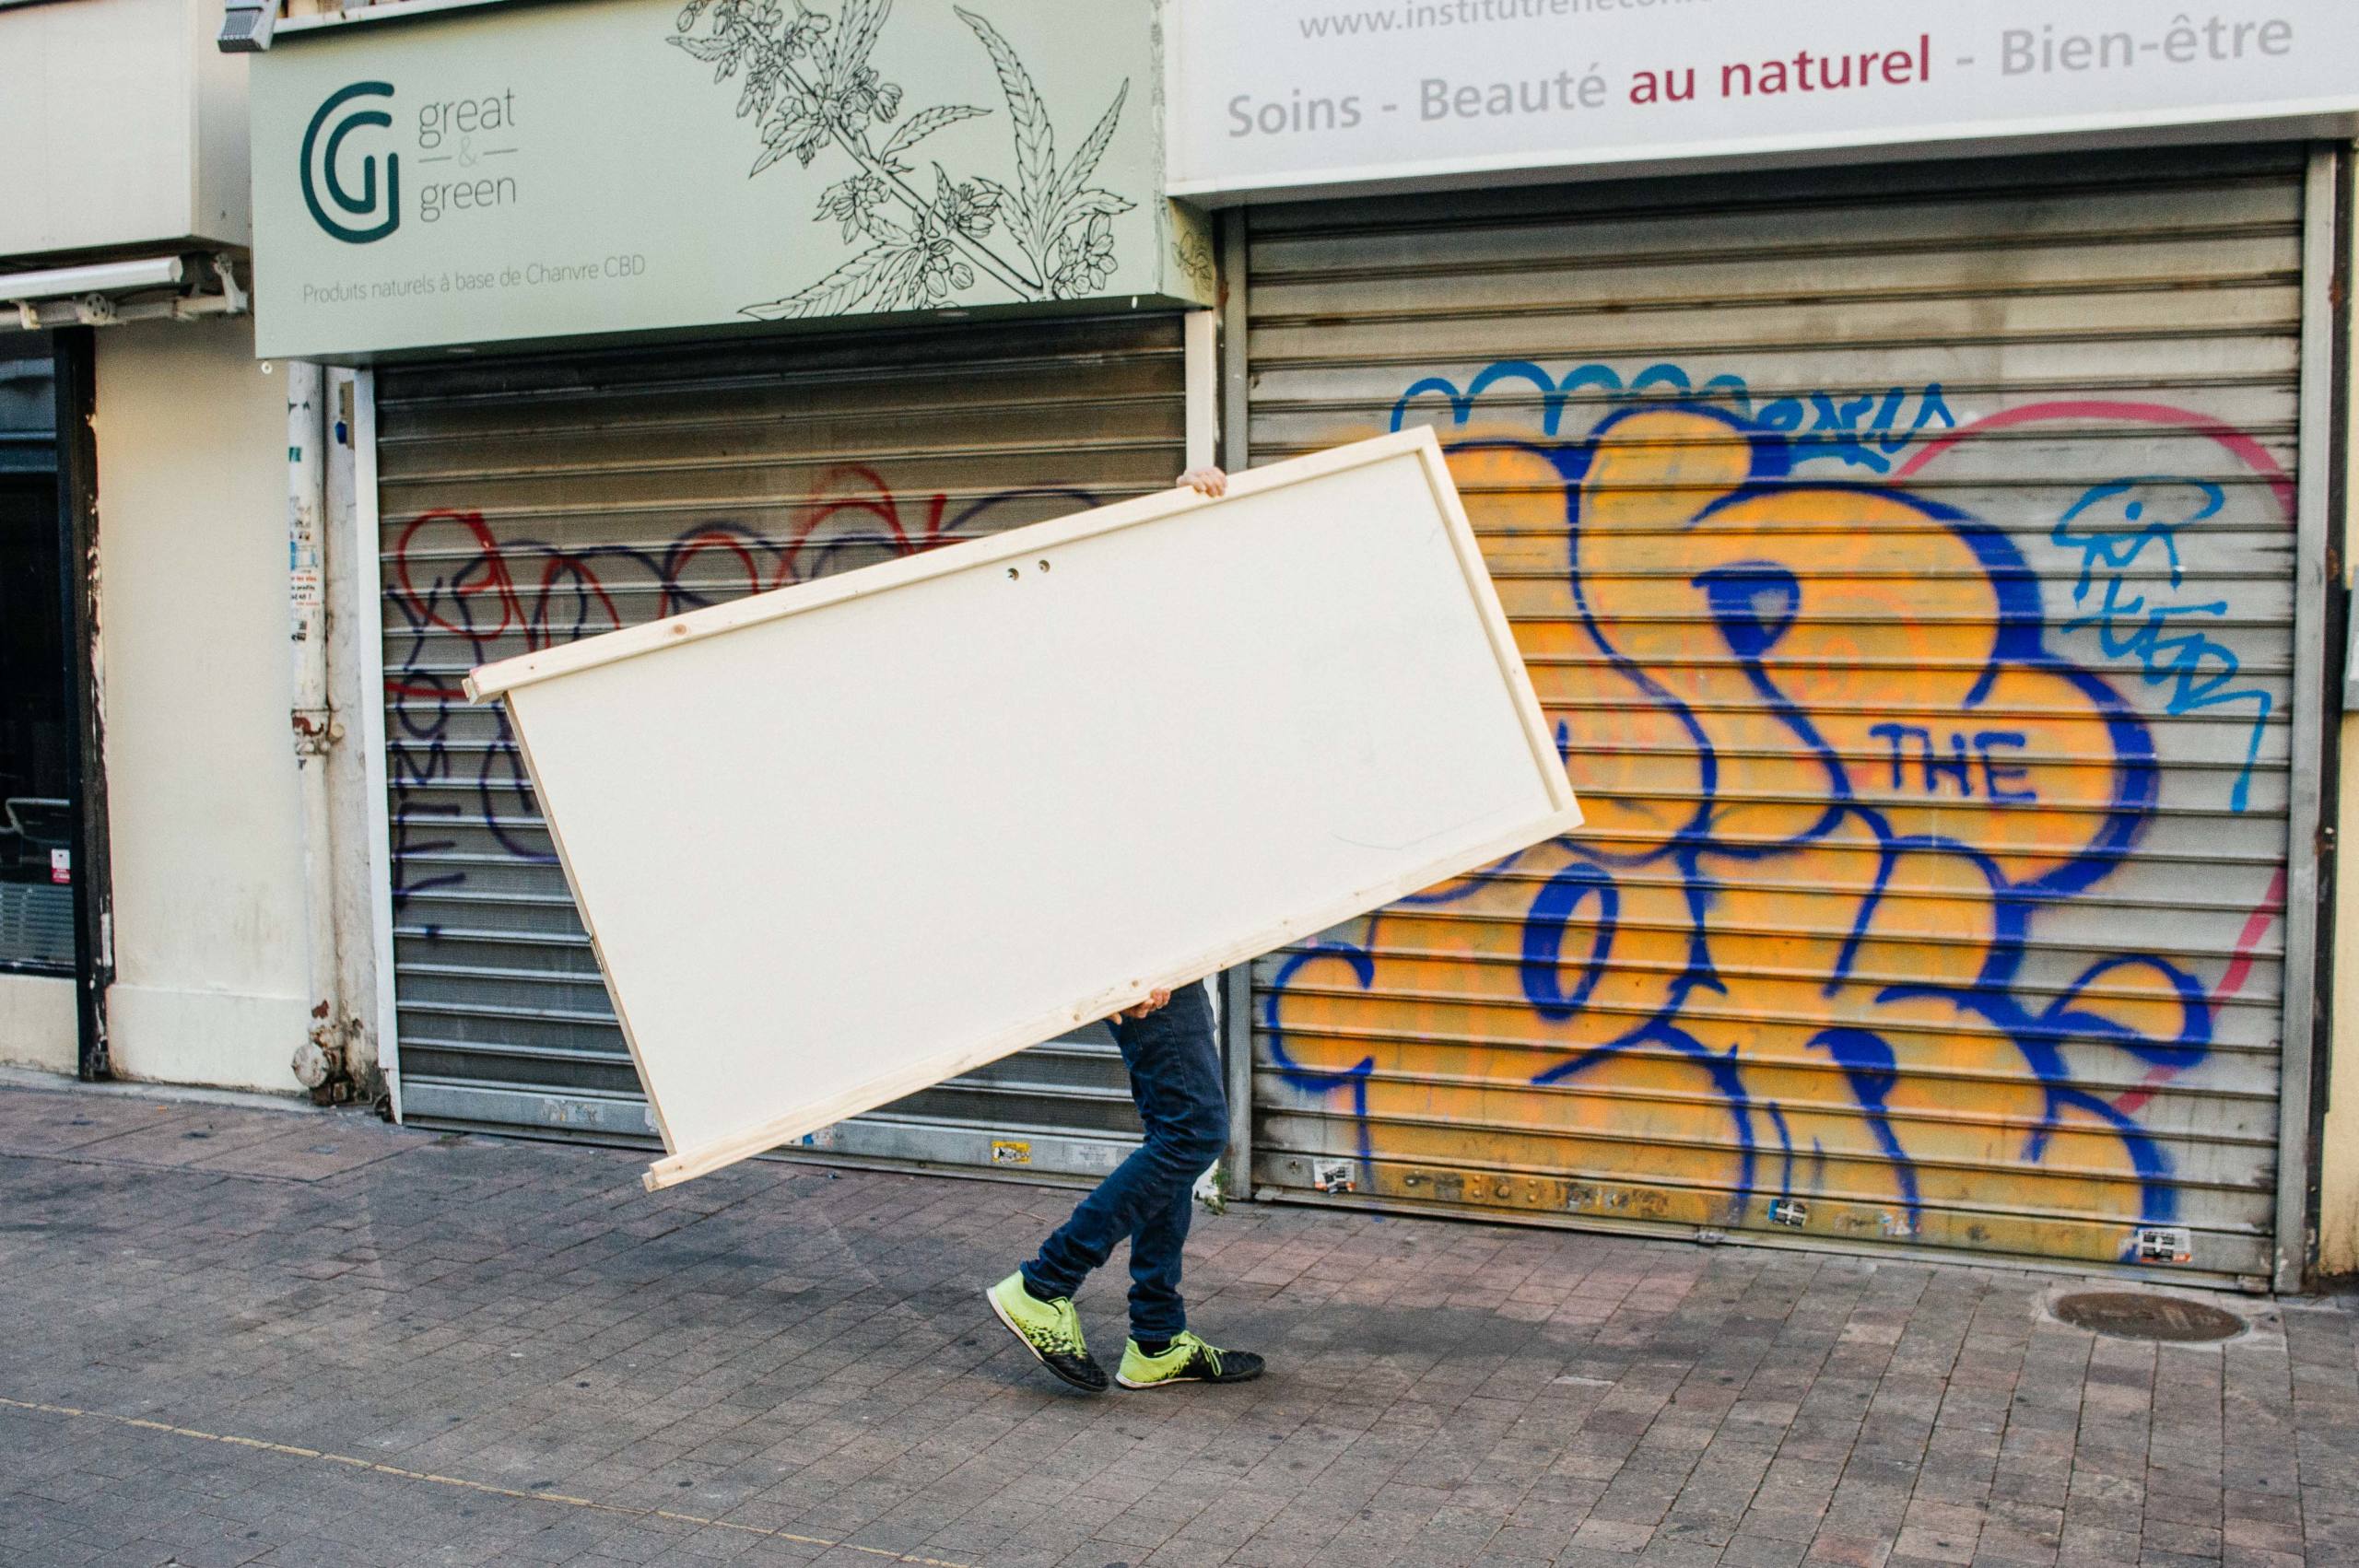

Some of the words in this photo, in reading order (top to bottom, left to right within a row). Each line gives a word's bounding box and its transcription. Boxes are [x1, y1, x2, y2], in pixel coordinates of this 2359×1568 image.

[1227, 88, 1362, 137] Soins
[1420, 62, 1607, 122] Beauté
[1628, 67, 1696, 106] au
[1720, 33, 1931, 99] naturel
[2001, 13, 2294, 76] Bien-être
[417, 87, 516, 150] great
[458, 135, 477, 168] &
[419, 176, 517, 223] green
[302, 282, 368, 304] Produits
[371, 275, 436, 298] naturels
[440, 273, 451, 293] à
[454, 271, 495, 291] base
[499, 266, 522, 287] de
[525, 262, 600, 286] Chanvre
[604, 254, 646, 278] CBD
[1869, 722, 2038, 803] THE
